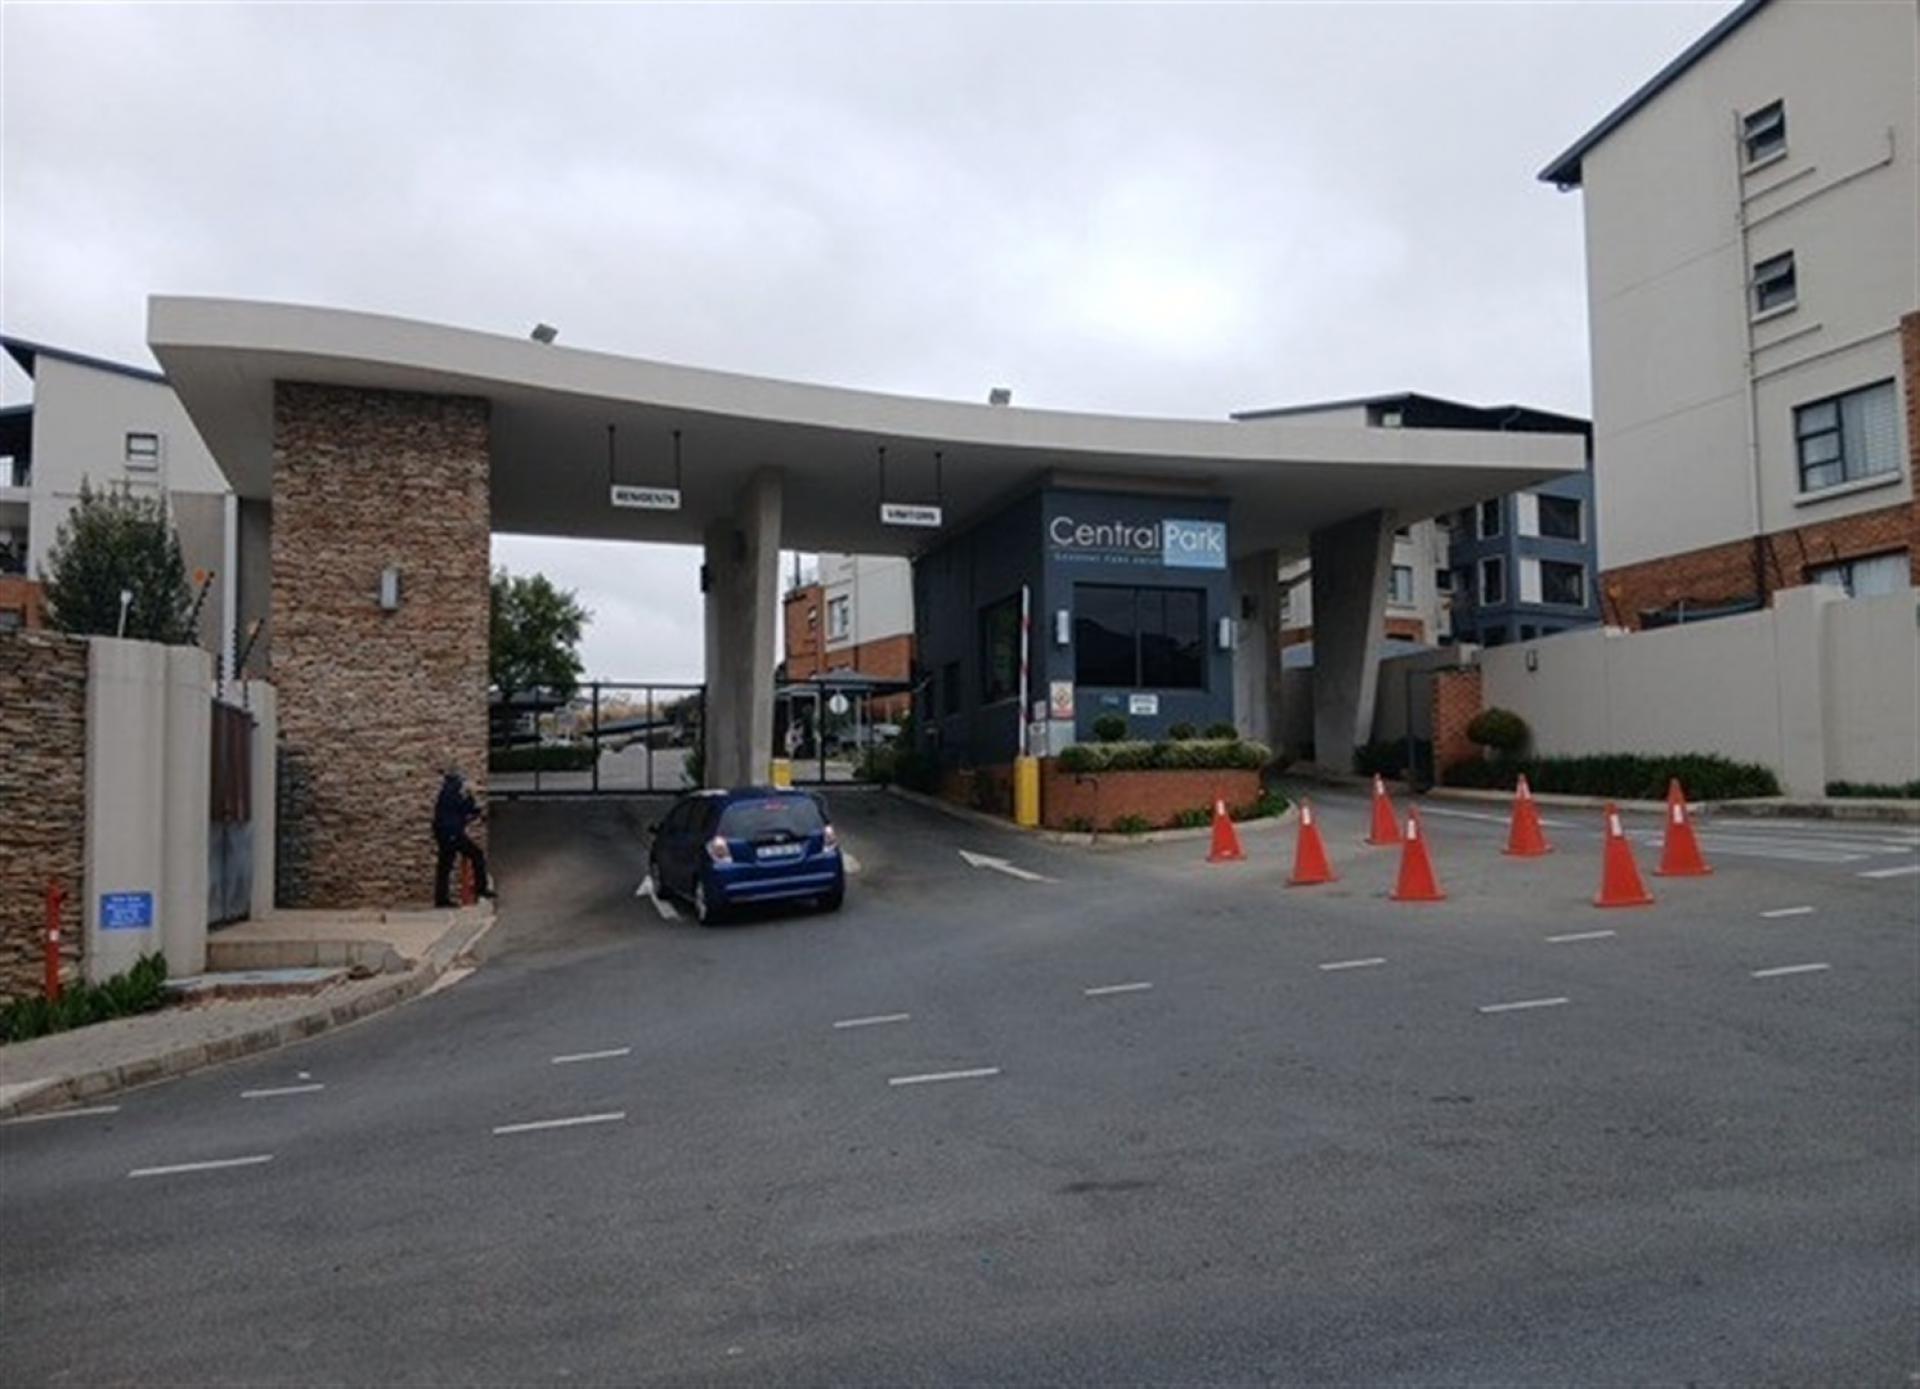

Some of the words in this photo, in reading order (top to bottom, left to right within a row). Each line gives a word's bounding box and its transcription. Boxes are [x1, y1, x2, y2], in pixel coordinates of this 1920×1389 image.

[616, 491, 675, 504] RESIDENTS
[887, 509, 936, 521] VISITORS
[1050, 516, 1159, 549] Central
[1166, 524, 1222, 552] Park
